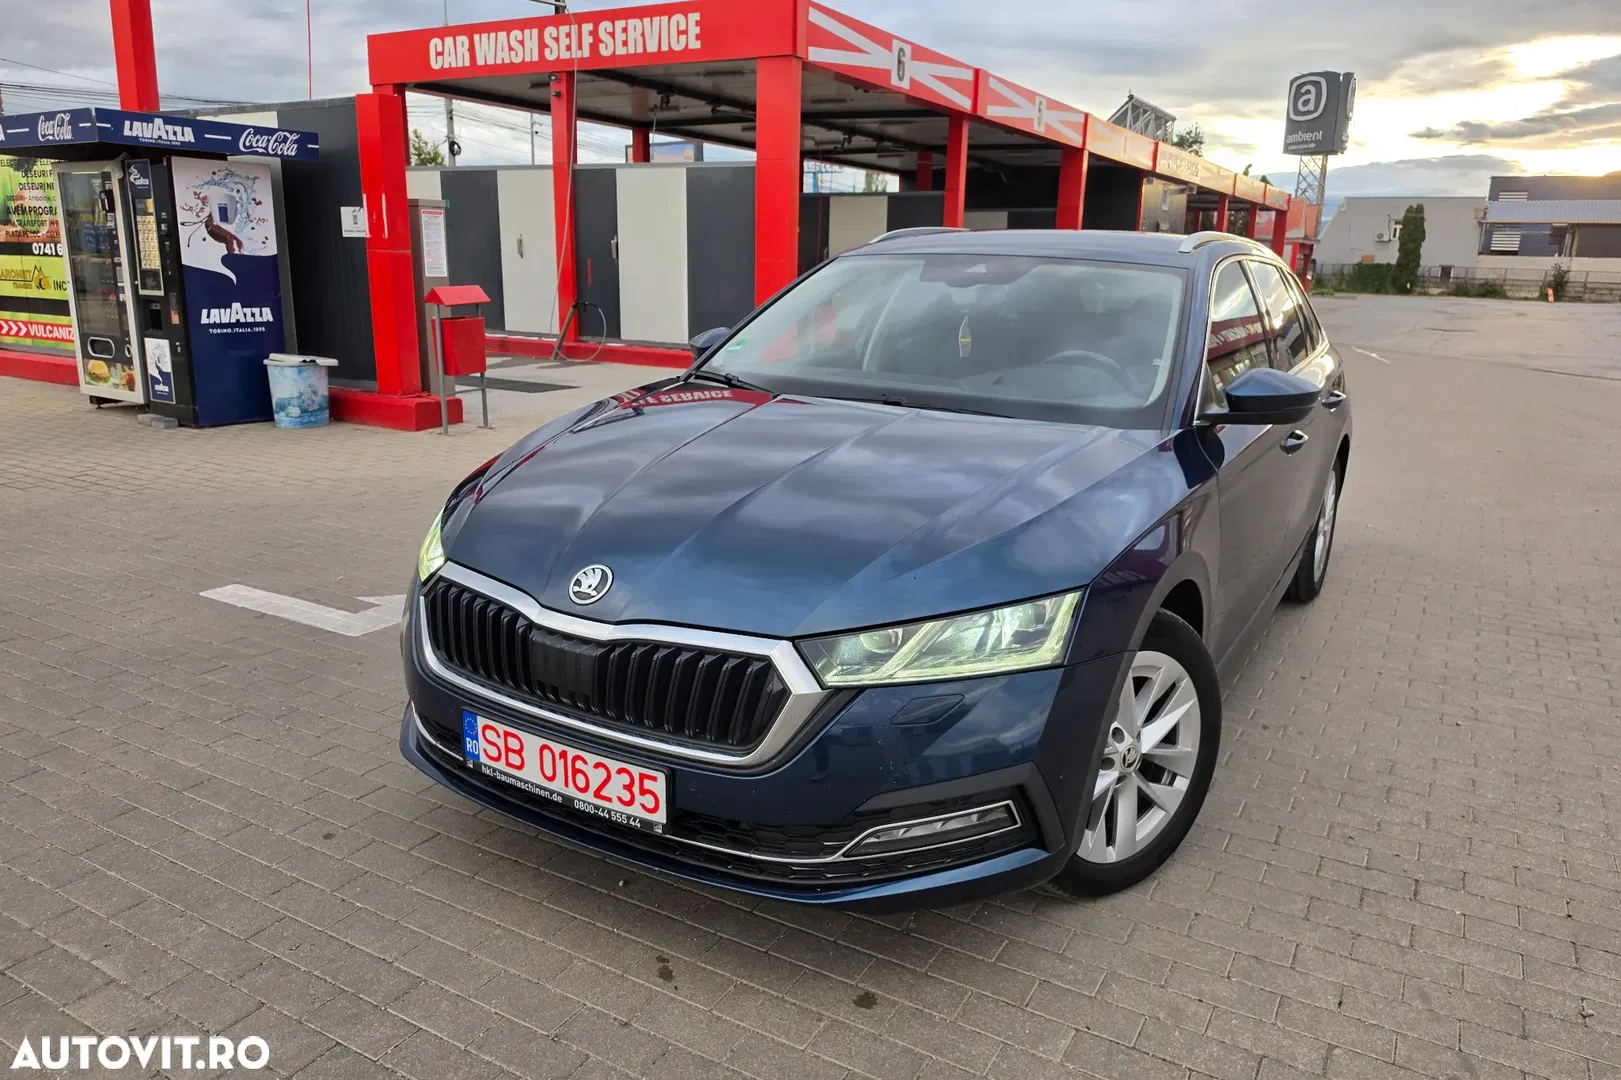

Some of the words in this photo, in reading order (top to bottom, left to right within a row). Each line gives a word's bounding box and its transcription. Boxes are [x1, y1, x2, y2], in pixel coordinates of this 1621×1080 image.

[428, 35, 470, 70] CAR
[473, 28, 539, 66] WASH
[543, 23, 593, 61] SELF
[597, 12, 701, 57] SERVICE
[897, 47, 906, 82] 6
[123, 117, 196, 143] LAVAZZA
[239, 128, 301, 156] Coca-Cola
[1286, 130, 1323, 143] ambient
[32, 242, 56, 256] 0741
[200, 302, 274, 324] LAVAZZA
[466, 737, 480, 755] RO
[481, 724, 526, 771] SB
[538, 743, 660, 814] 016235
[481, 765, 563, 803] hkl-baumaschinen.de
[574, 799, 609, 821] 0800-44
[611, 808, 628, 824] 555
[629, 816, 641, 828] 44
